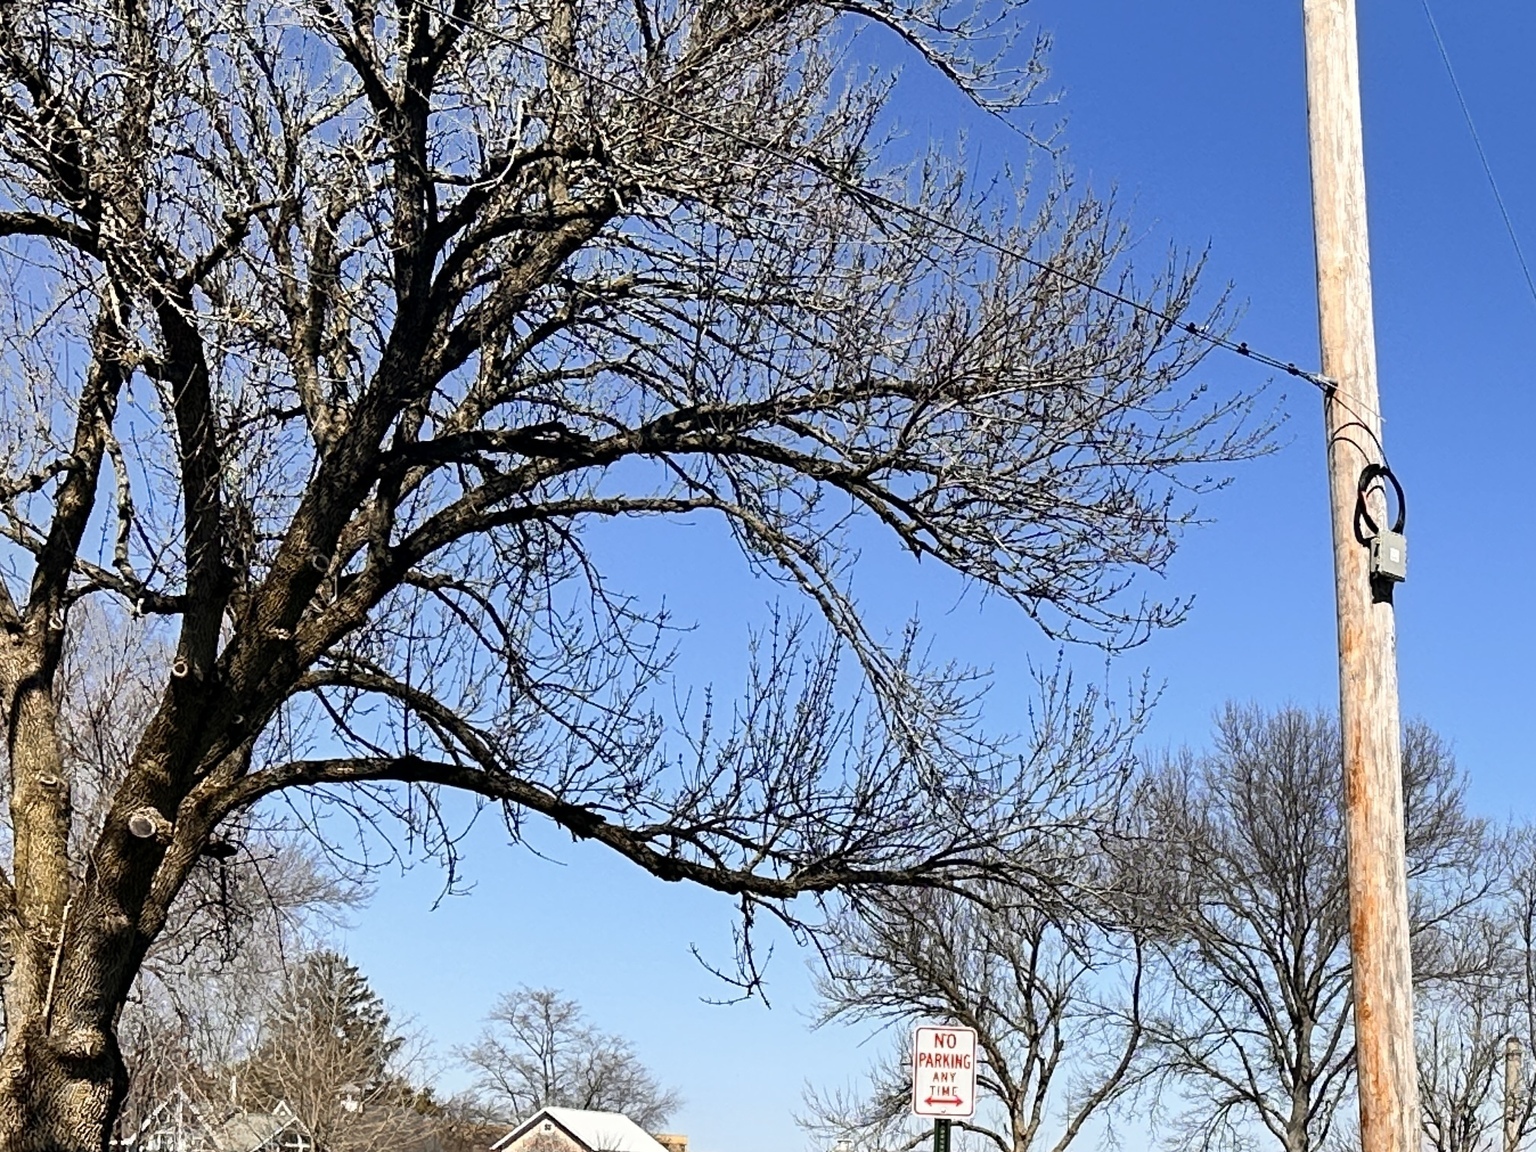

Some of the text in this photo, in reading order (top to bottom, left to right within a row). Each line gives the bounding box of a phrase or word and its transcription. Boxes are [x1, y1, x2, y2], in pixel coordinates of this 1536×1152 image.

[934, 1033, 957, 1049] NO
[919, 1052, 971, 1069] PARKING
[932, 1072, 957, 1083] ANY
[929, 1085, 959, 1097] TIME
